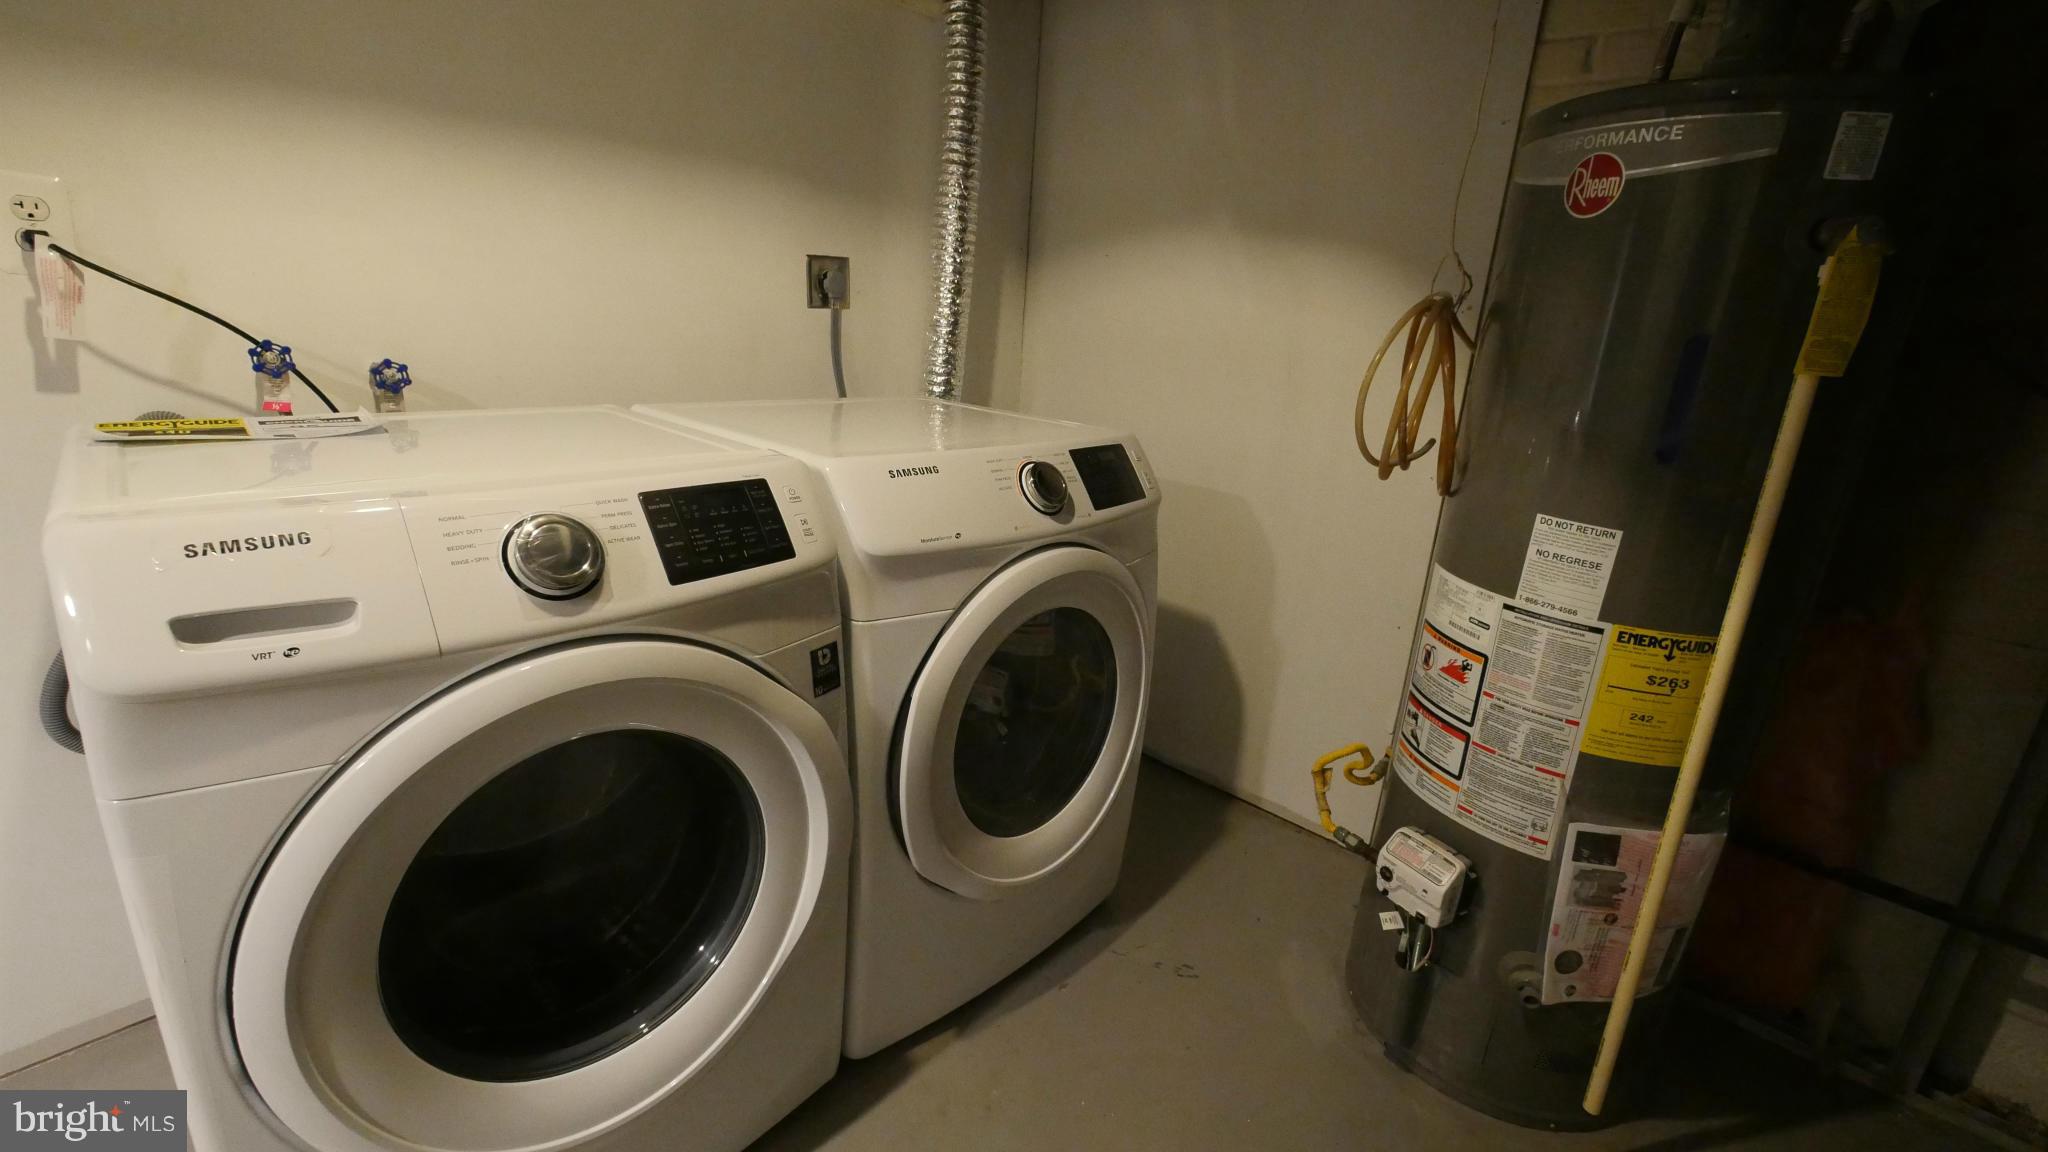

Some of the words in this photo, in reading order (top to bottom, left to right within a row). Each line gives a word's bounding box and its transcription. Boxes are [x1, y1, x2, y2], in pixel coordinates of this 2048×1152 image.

[1568, 156, 1620, 207] Rheem
[98, 418, 241, 429] ENERGYGUIDE
[888, 465, 940, 479] SAMSUNG
[1539, 516, 1553, 527] DO
[1554, 520, 1575, 533] NOT
[1575, 524, 1617, 540] RETURN
[183, 531, 312, 559] SAMSUNG
[1535, 548, 1550, 559] NO
[1552, 552, 1604, 571] REGRESE
[1616, 630, 1717, 656] ENERGYGUID
[1645, 675, 1690, 690] $263
[1629, 712, 1654, 723] 242
